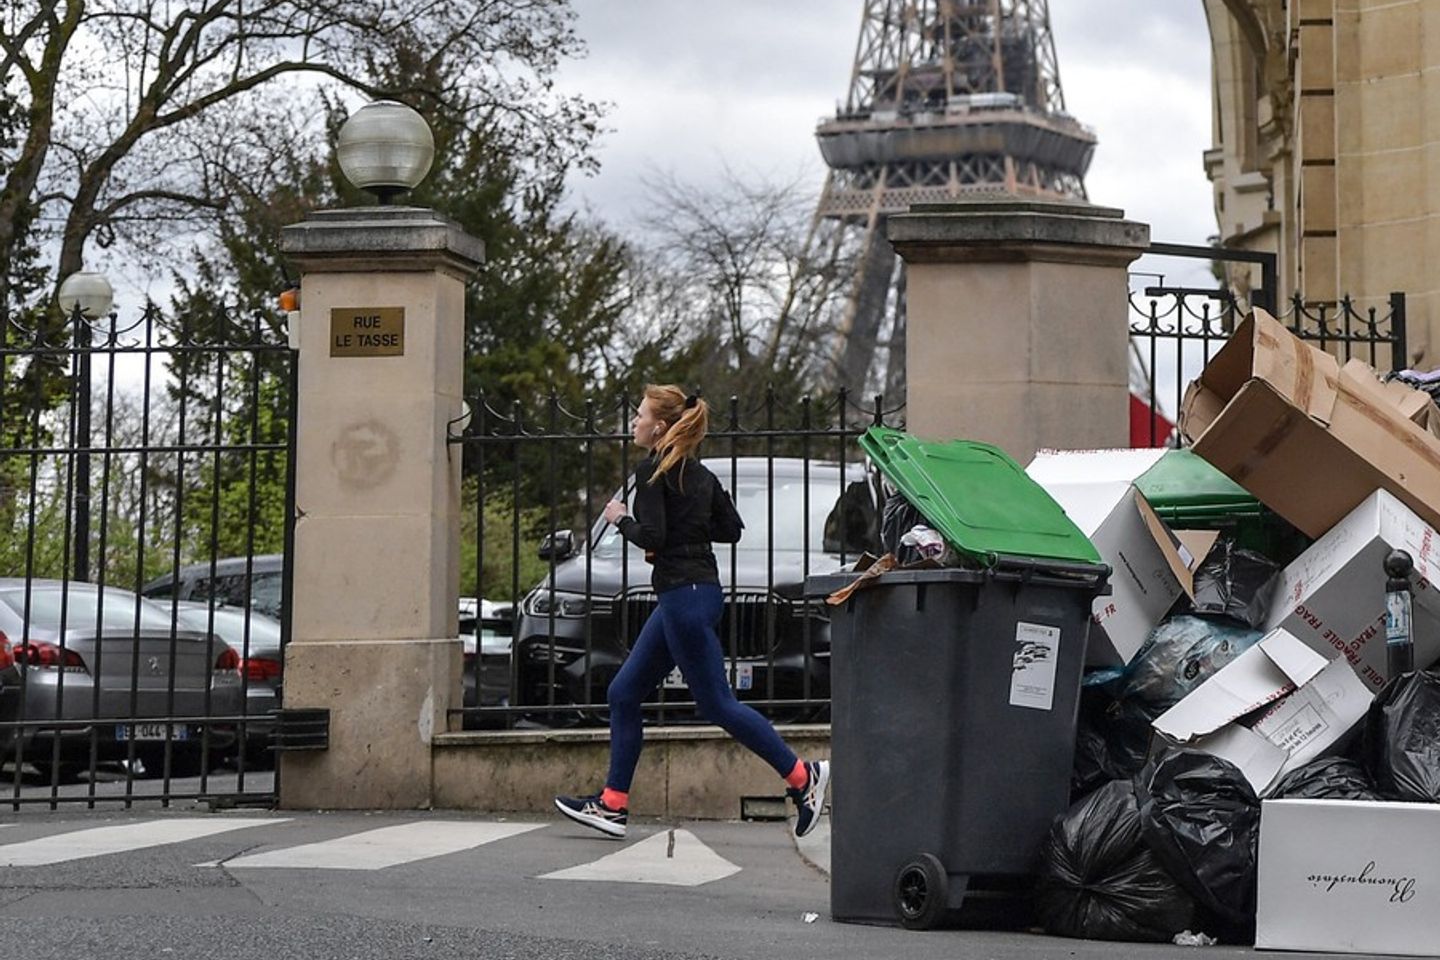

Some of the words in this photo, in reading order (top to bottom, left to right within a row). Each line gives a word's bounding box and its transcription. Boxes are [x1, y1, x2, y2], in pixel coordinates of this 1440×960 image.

[353, 315, 382, 329] RUE
[335, 334, 353, 348] LE
[356, 333, 400, 348] TASSE
